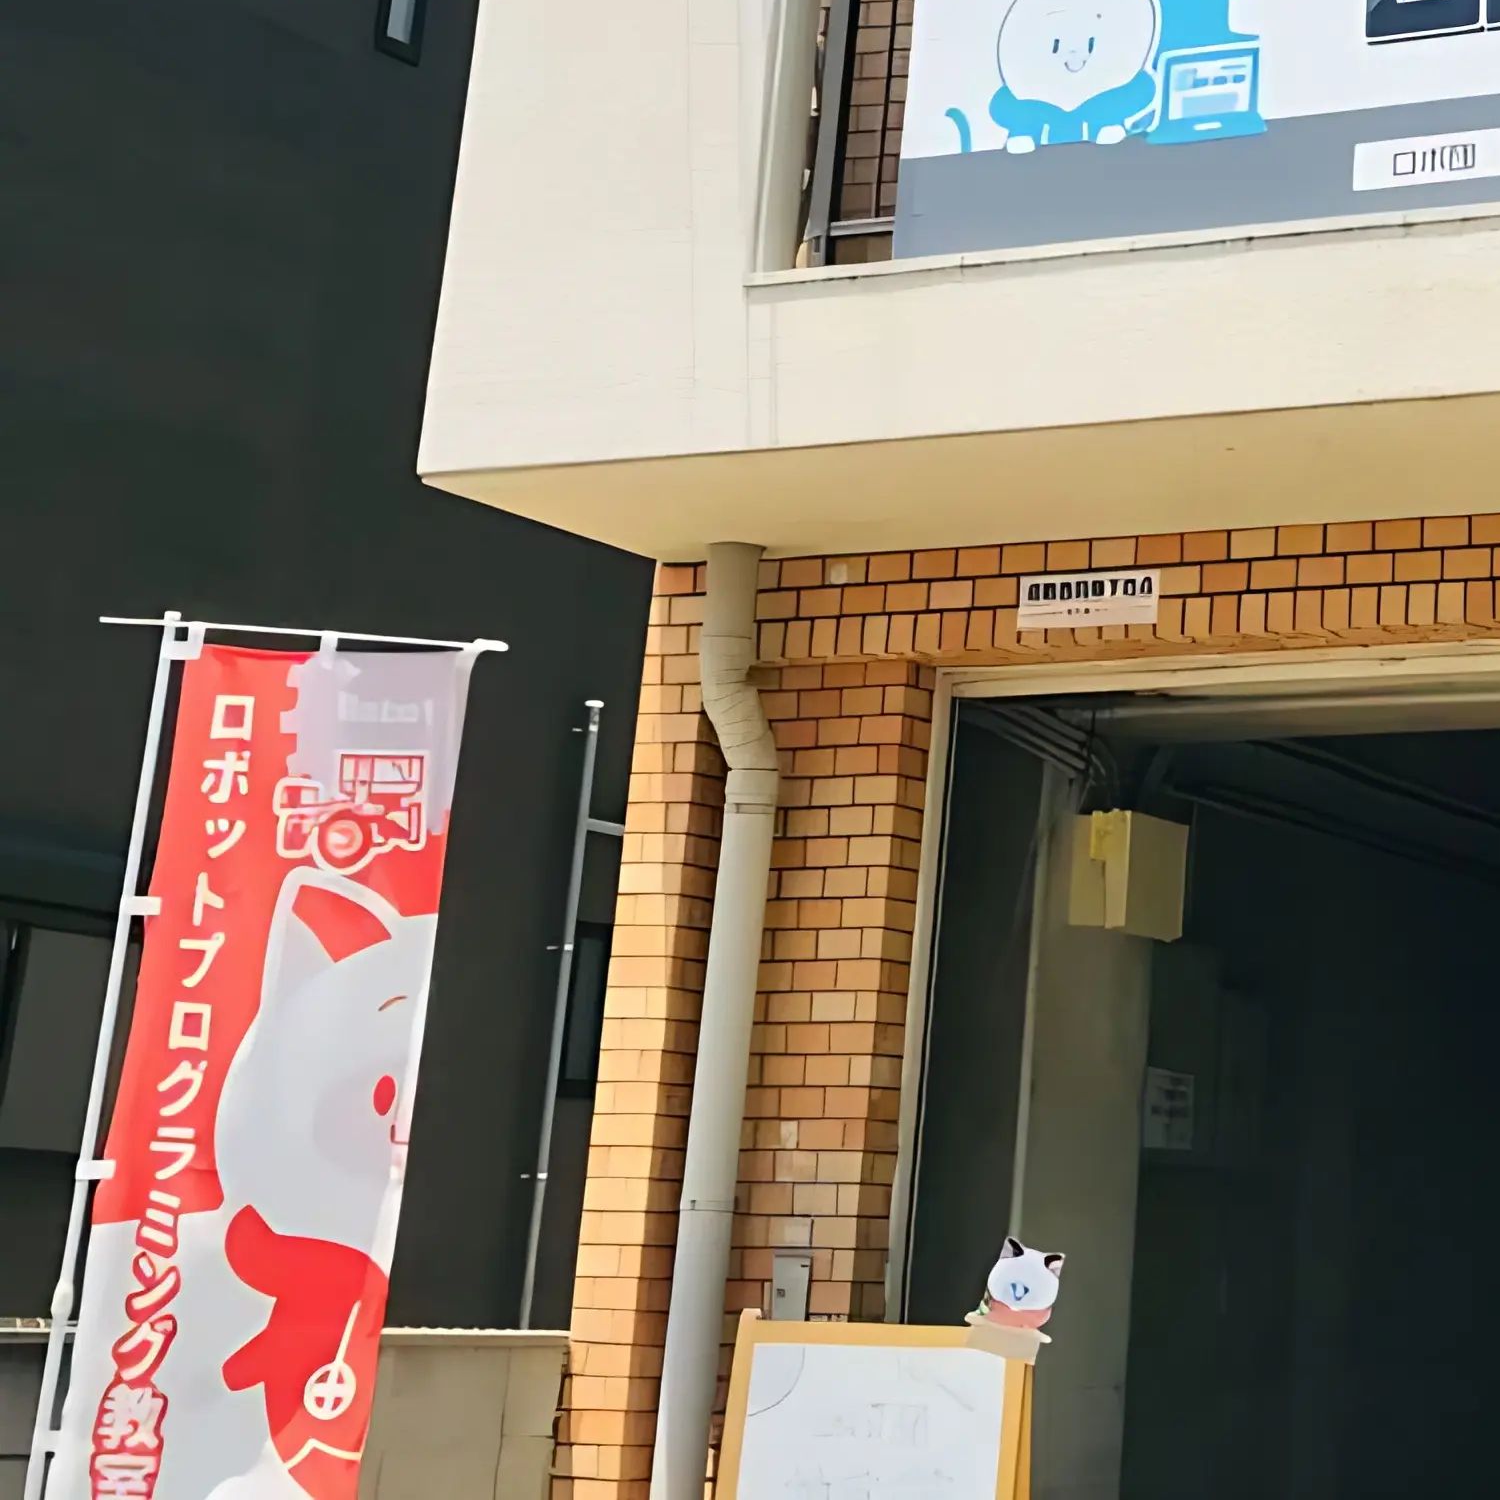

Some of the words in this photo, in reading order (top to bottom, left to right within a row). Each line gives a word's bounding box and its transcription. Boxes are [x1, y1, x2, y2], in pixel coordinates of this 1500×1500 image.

[92, 692, 255, 1500] ロボットプログラミング教室
